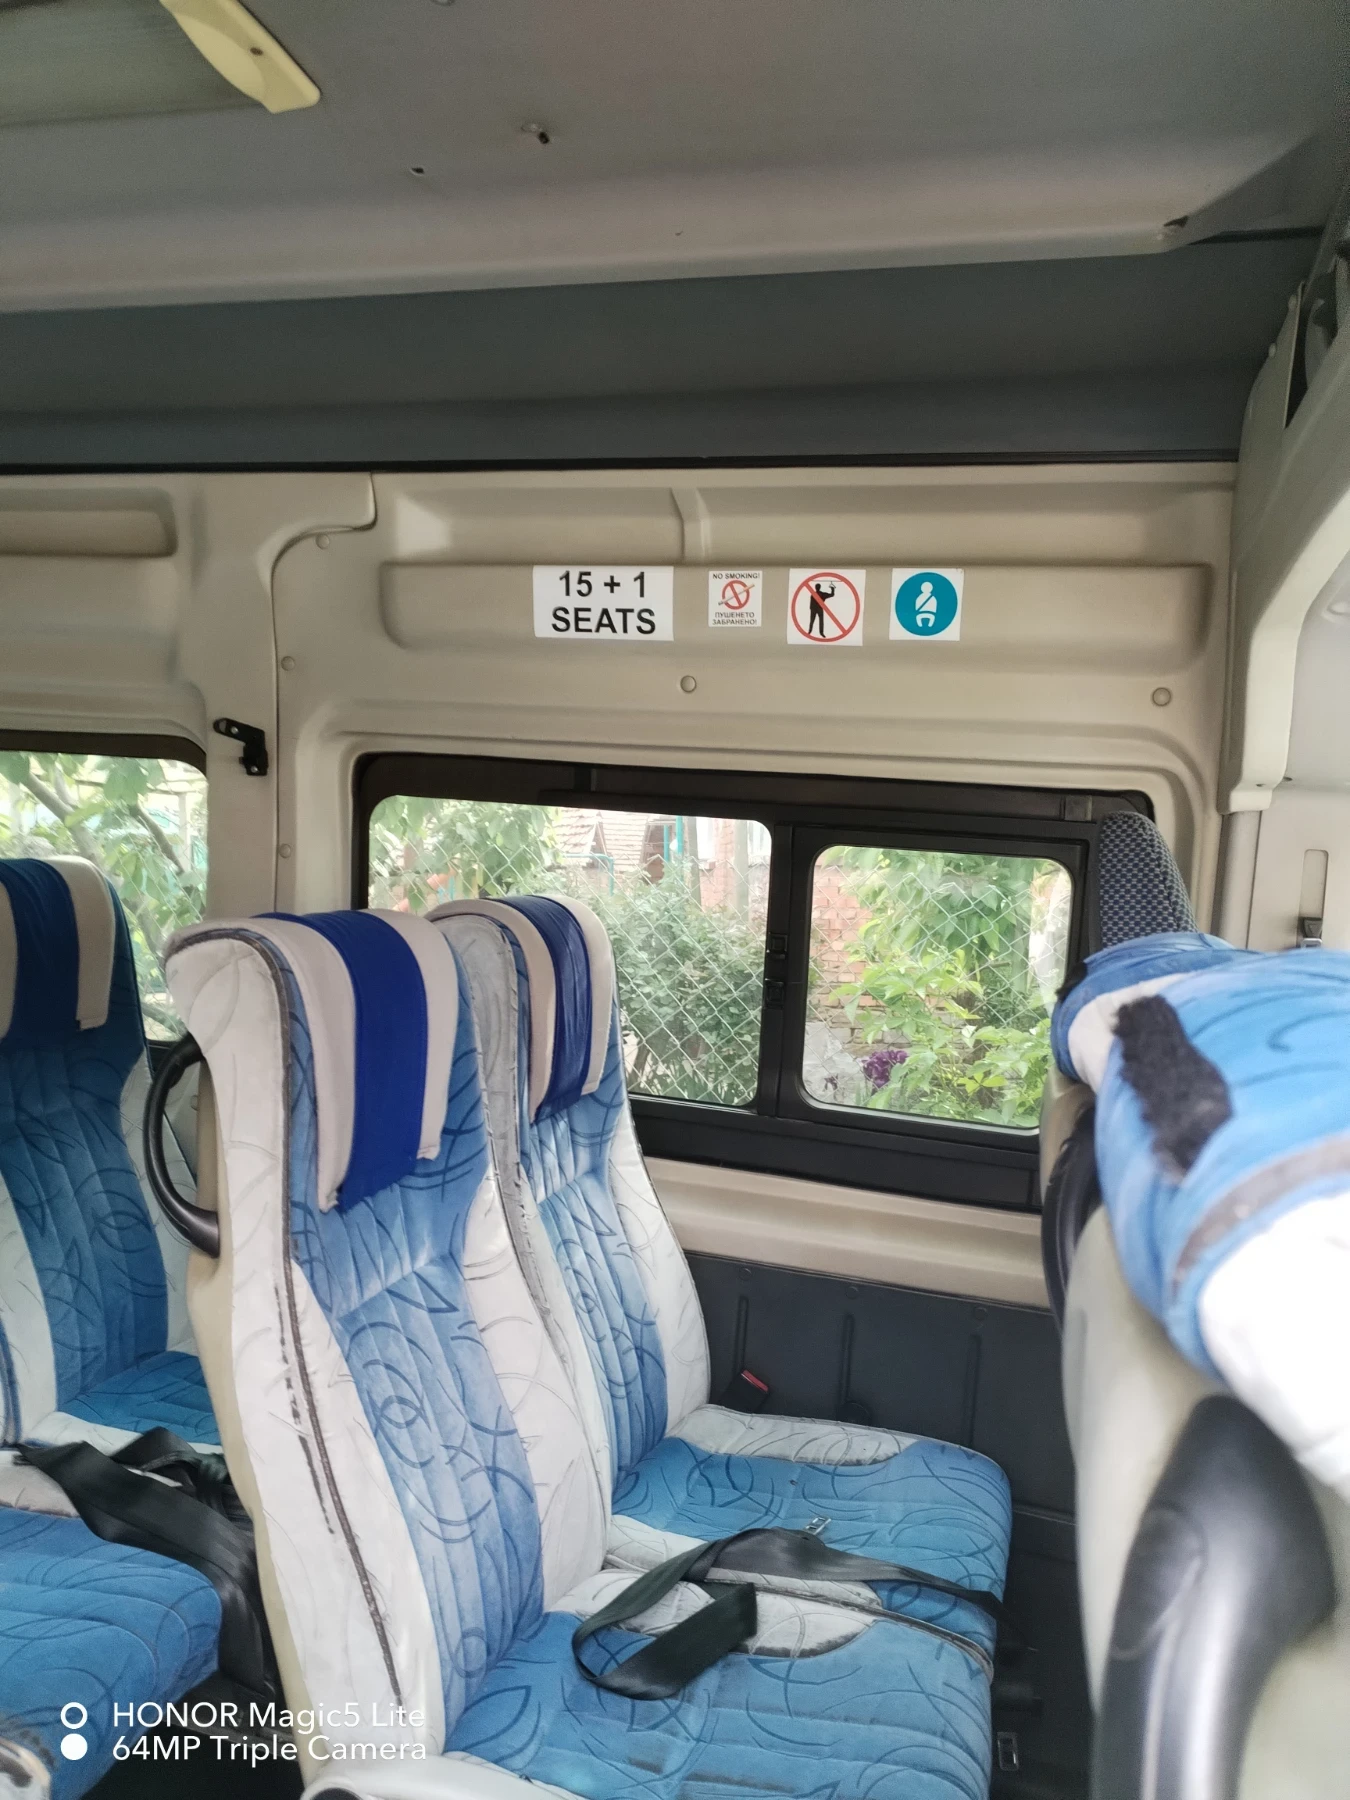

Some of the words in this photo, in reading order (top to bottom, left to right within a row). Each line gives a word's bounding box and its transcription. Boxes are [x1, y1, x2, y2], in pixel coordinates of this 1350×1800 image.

[559, 570, 593, 597] 15
[603, 575, 621, 594] +
[633, 571, 645, 598] 1
[551, 606, 656, 635] SEATS
